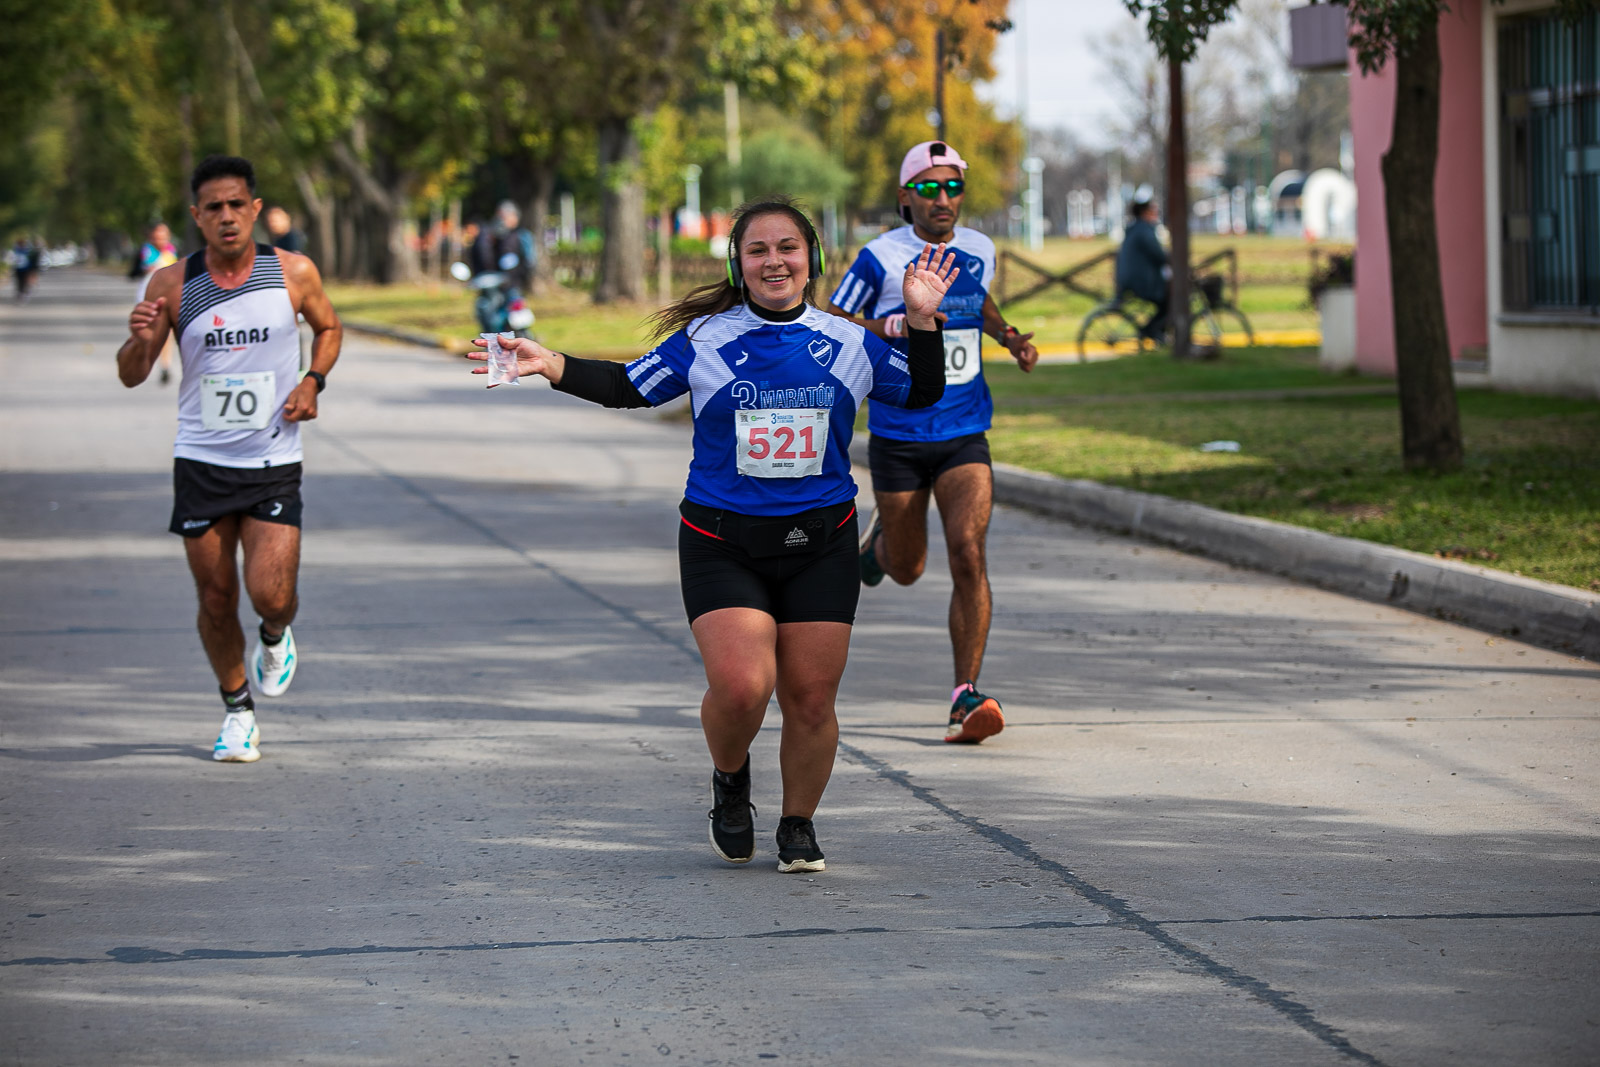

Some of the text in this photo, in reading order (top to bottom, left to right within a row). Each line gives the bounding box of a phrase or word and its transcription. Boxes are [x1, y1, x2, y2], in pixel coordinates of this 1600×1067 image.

[204, 327, 269, 347] ATENAS
[944, 346, 967, 371] 0
[215, 390, 258, 417] 70
[731, 380, 835, 410] 3 MARATÓN
[747, 426, 818, 460] 521
